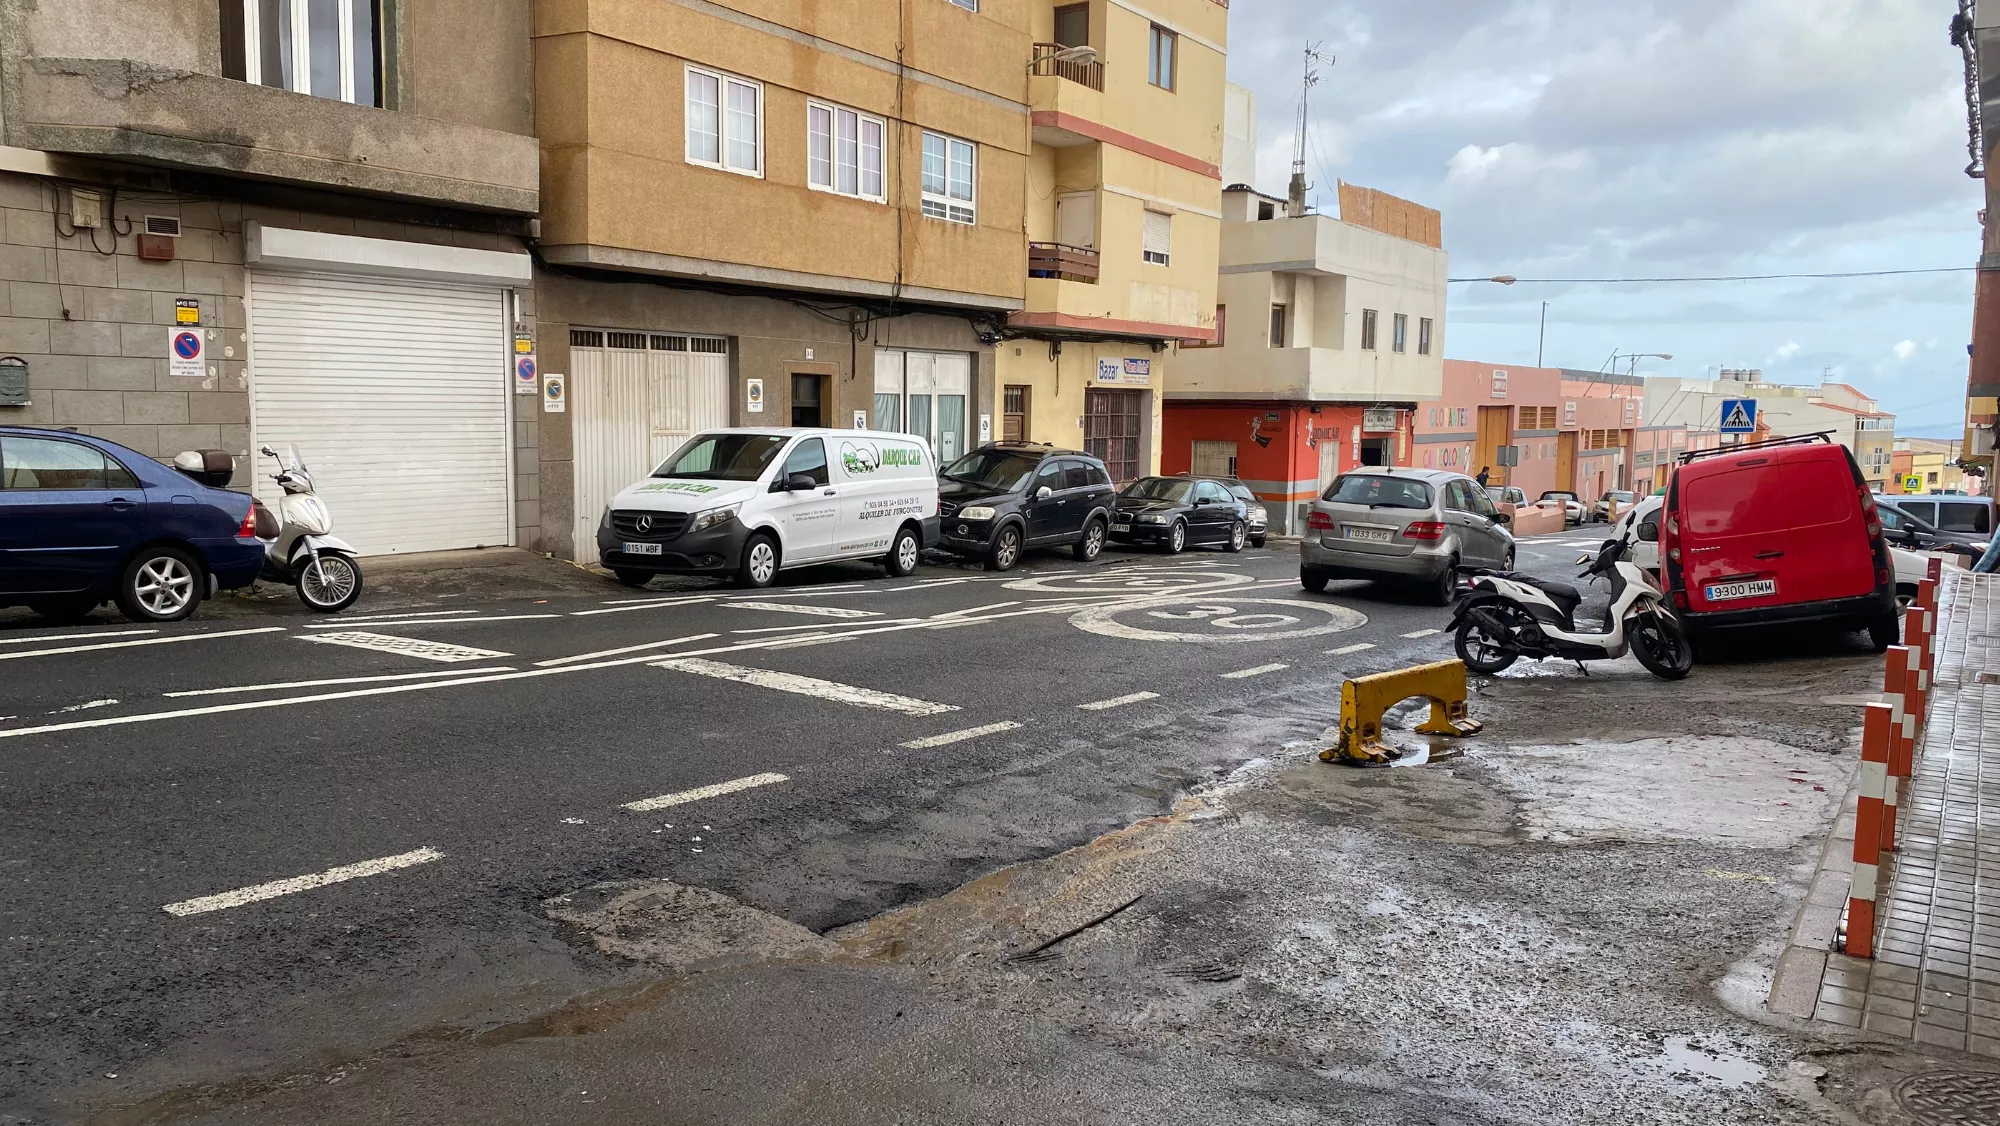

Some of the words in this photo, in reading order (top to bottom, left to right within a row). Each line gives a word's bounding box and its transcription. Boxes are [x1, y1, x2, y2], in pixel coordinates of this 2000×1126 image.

[1099, 360, 1118, 380] Bazar
[882, 448, 907, 468] DARQUE
[908, 448, 921, 466] CAR
[859, 510, 884, 520] ALQUILER
[884, 509, 892, 517] DE
[893, 505, 923, 516] FURGONETAS
[1351, 529, 1370, 538] 1033
[1371, 531, 1387, 540] GRG
[626, 544, 643, 553] 0151
[1715, 584, 1745, 598] 9300
[1748, 581, 1772, 594] HMM
[1147, 605, 1301, 629] 30
